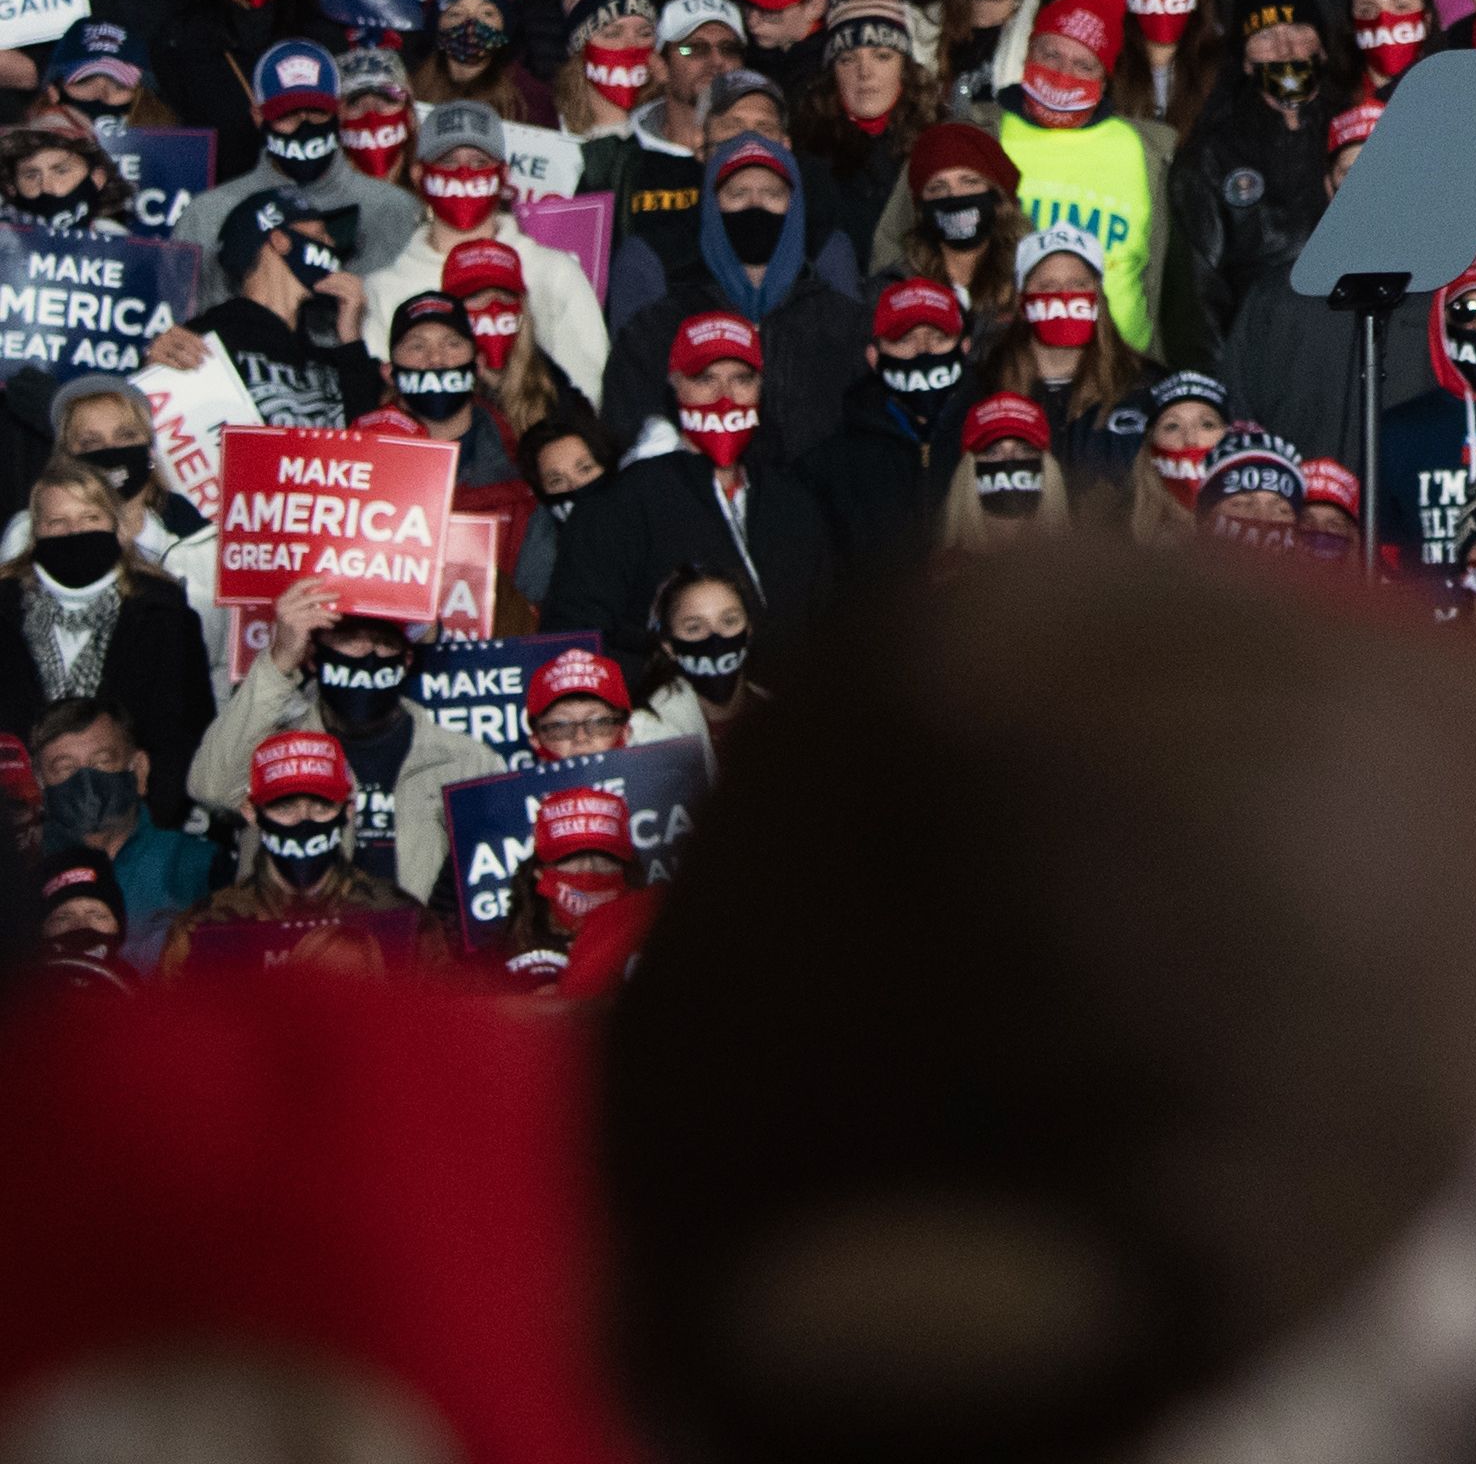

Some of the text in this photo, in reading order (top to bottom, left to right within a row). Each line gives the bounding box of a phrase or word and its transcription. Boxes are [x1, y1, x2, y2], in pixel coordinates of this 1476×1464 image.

[586, 64, 649, 87] MAG
[266, 136, 337, 161] MAGA
[1022, 198, 1131, 248] UMP
[29, 252, 123, 288] MAKE
[0, 288, 174, 334] MERICA
[0, 334, 136, 370] EAT AGA
[236, 351, 341, 388] Trum
[398, 370, 473, 394] MAGA
[883, 362, 962, 393] MAGA
[680, 409, 759, 432] MAGA
[146, 392, 219, 514] AMER
[279, 456, 373, 489] MAKE
[1222, 469, 1294, 497] 2020
[225, 491, 432, 546] AMERICA
[224, 543, 430, 585] GREAT AGAIN
[322, 662, 404, 690] MAGA
[422, 667, 523, 700] MAKE
[260, 828, 341, 858] MAGA
